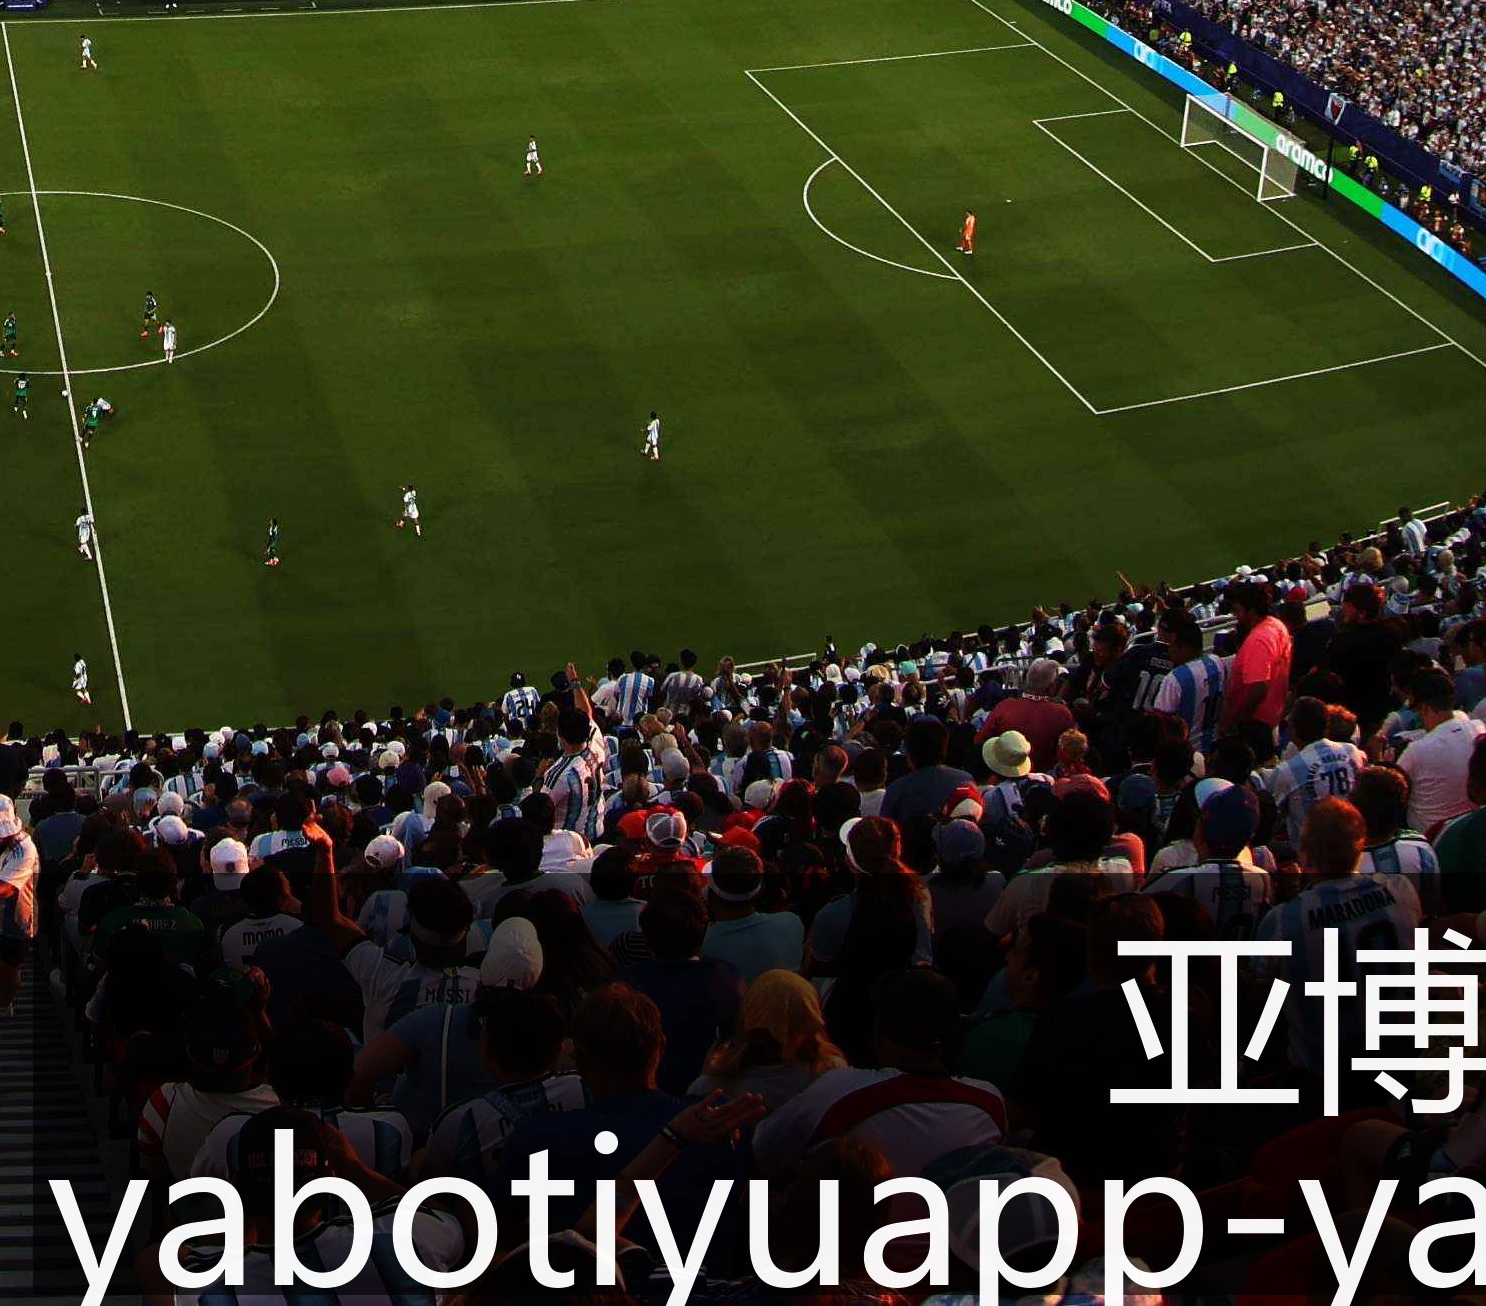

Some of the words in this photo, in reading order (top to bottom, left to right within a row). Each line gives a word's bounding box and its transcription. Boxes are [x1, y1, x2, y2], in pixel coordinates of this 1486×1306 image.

[1276, 133, 1334, 184] aramco
[1307, 894, 1397, 929] MARADONA
[424, 987, 470, 1005] MESSI
